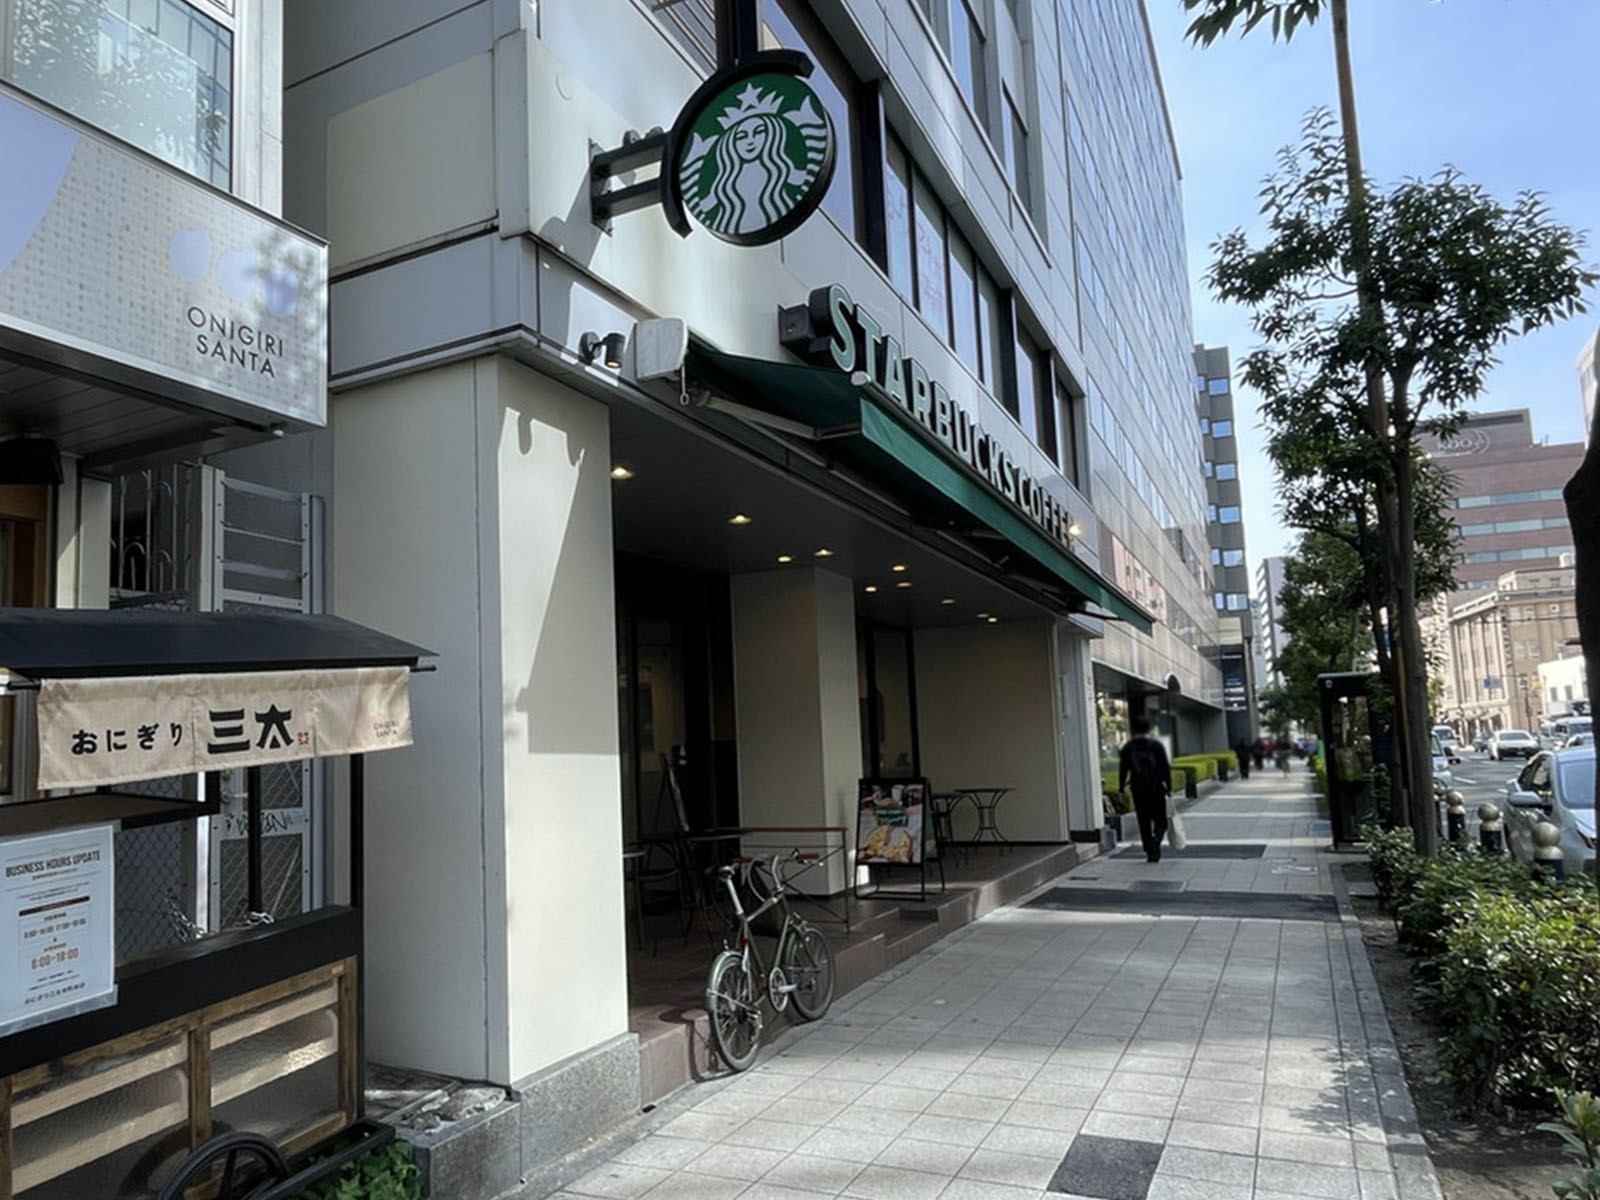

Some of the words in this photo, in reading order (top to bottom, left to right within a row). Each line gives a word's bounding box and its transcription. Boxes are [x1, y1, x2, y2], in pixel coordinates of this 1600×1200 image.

[187, 306, 283, 358] ONIGIRI
[196, 334, 275, 379] SANTA
[828, 283, 1016, 502] STARBUCKS
[71, 722, 183, 755] おにぎり
[207, 703, 295, 755] 三太
[5, 860, 45, 878] BUSINESS
[46, 855, 72, 869] HOURS
[73, 850, 101, 865] UPDATE
